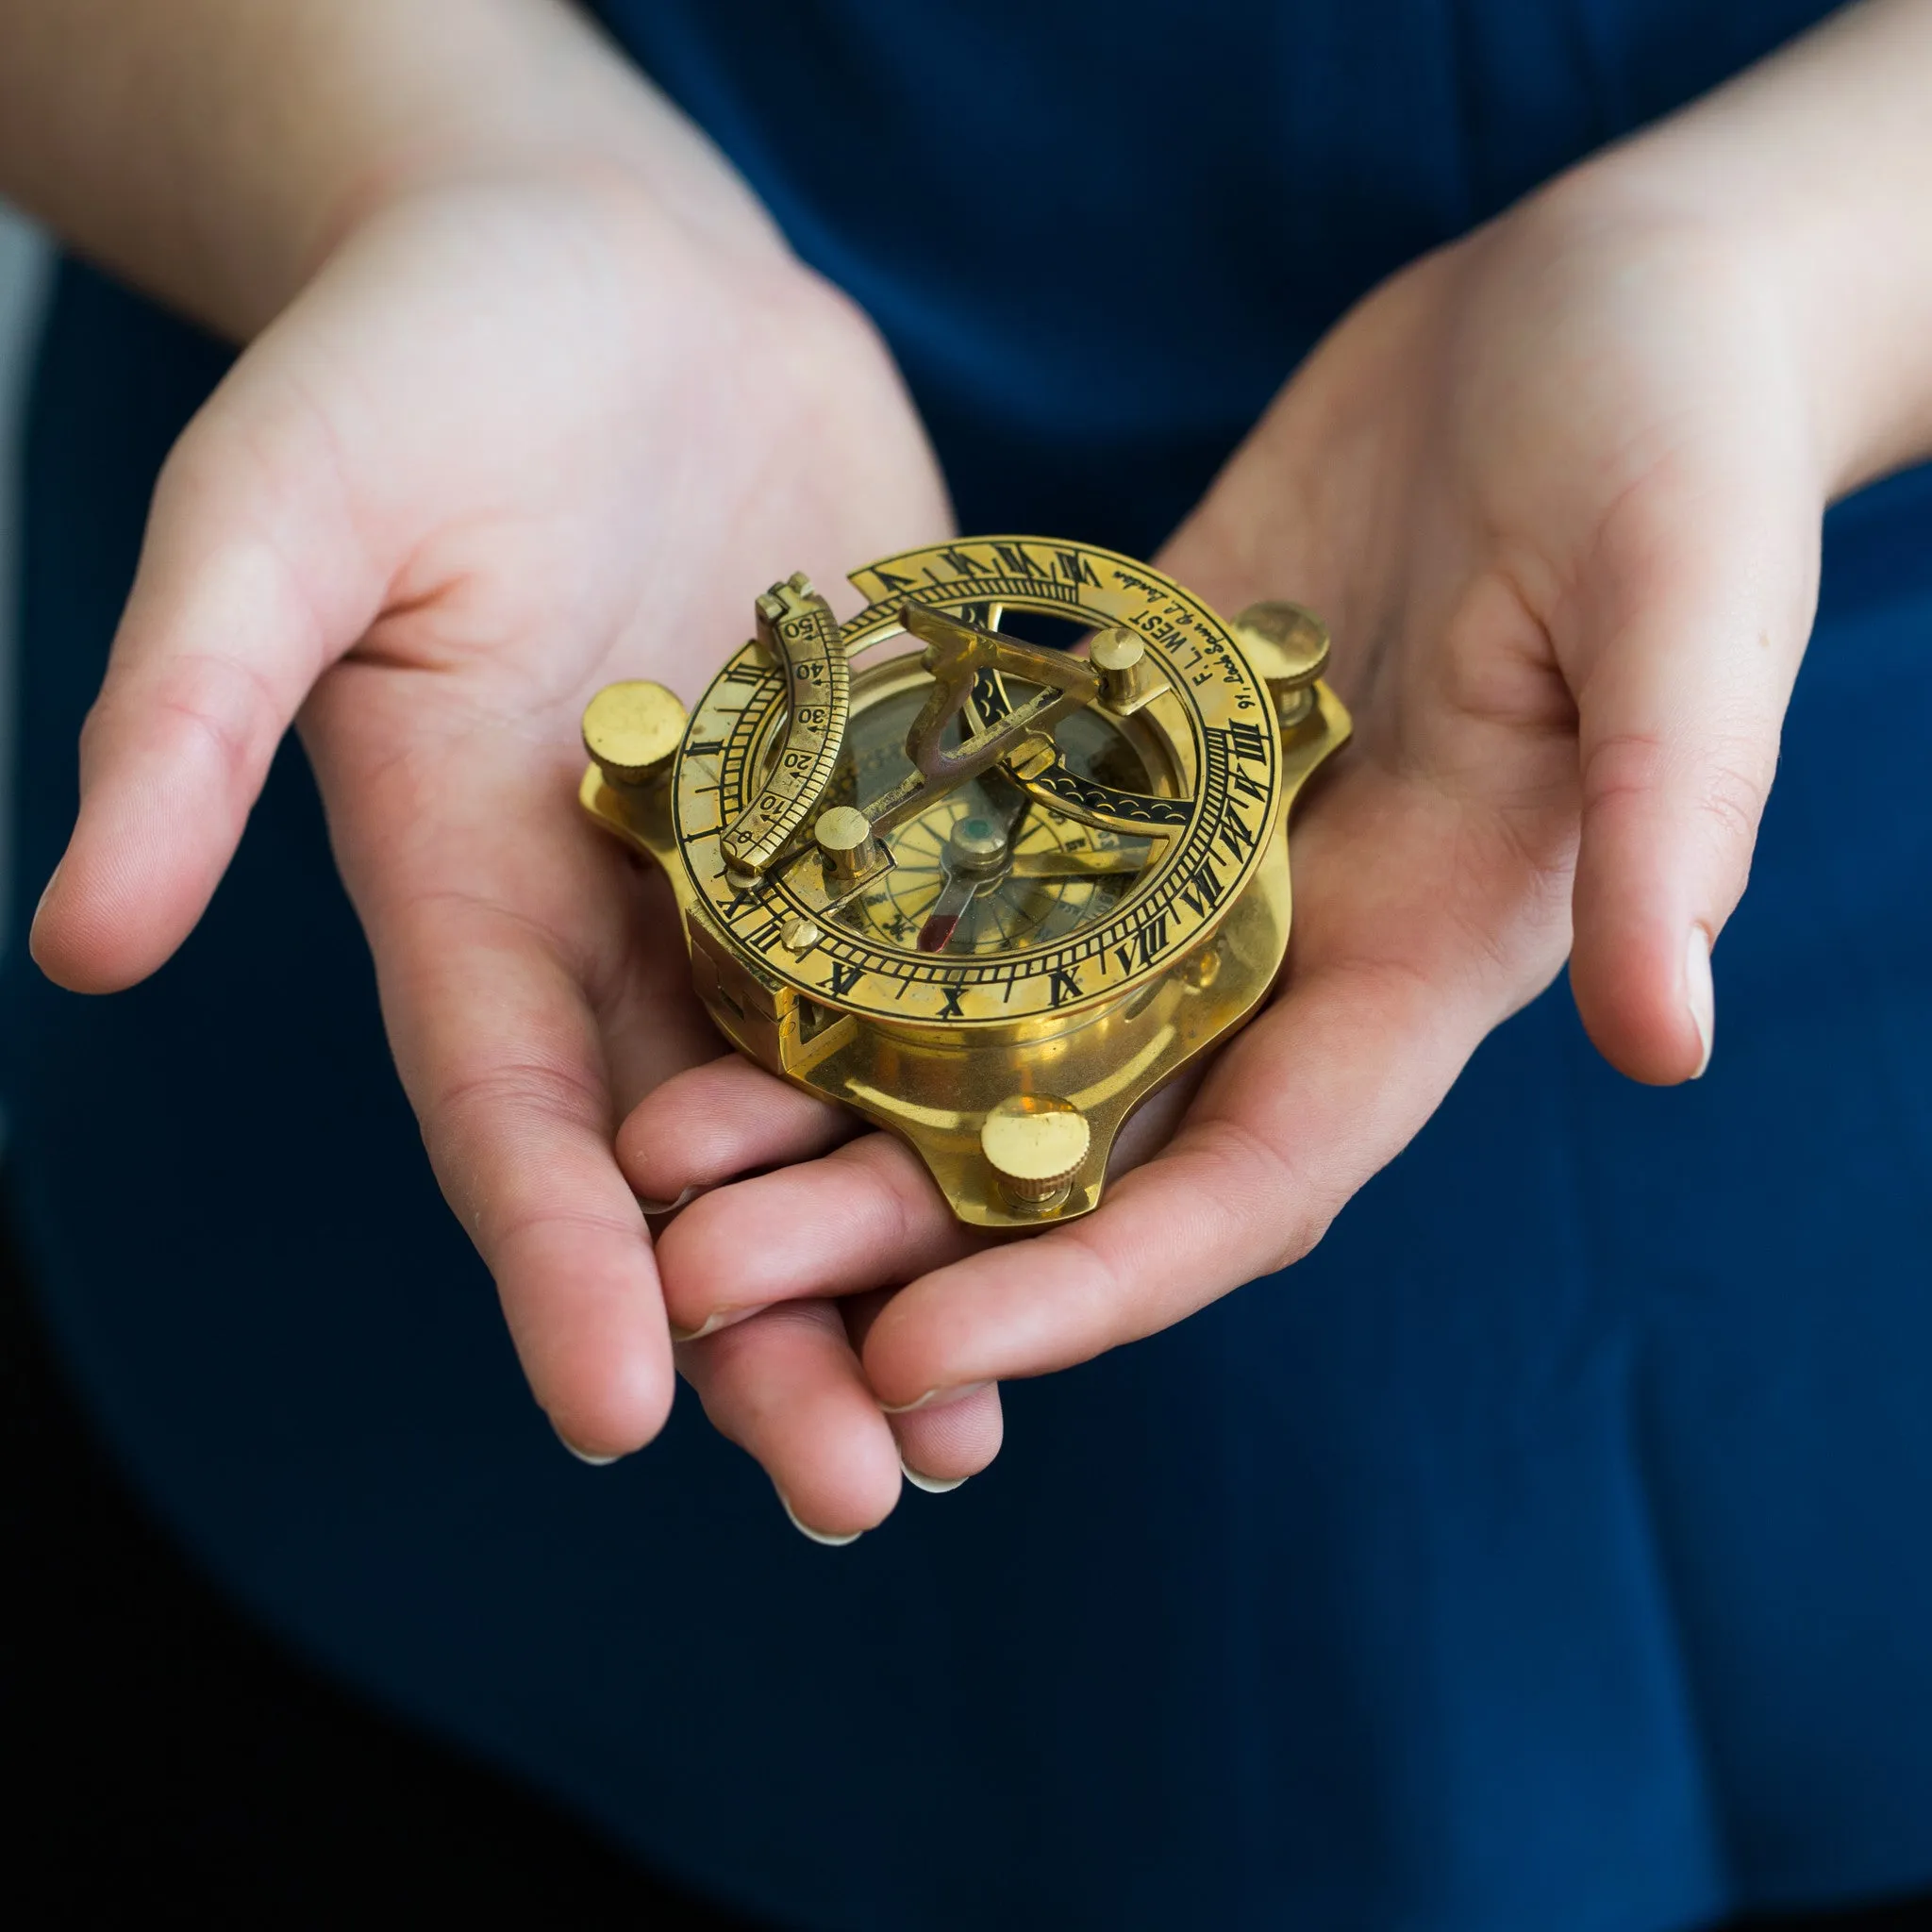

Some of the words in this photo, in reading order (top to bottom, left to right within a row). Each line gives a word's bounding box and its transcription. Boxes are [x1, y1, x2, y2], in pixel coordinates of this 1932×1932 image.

[1112, 571, 1168, 603] London
[784, 618, 813, 639] 50
[1128, 609, 1188, 654] WEST
[1183, 646, 1204, 670] L.
[796, 662, 824, 681] 40
[1191, 663, 1213, 687] F.
[798, 708, 825, 724] 30
[686, 740, 724, 758] II
[784, 753, 813, 771] 20
[759, 795, 787, 815] 10
[1048, 966, 1084, 1007] IX
[936, 987, 969, 1017] X
